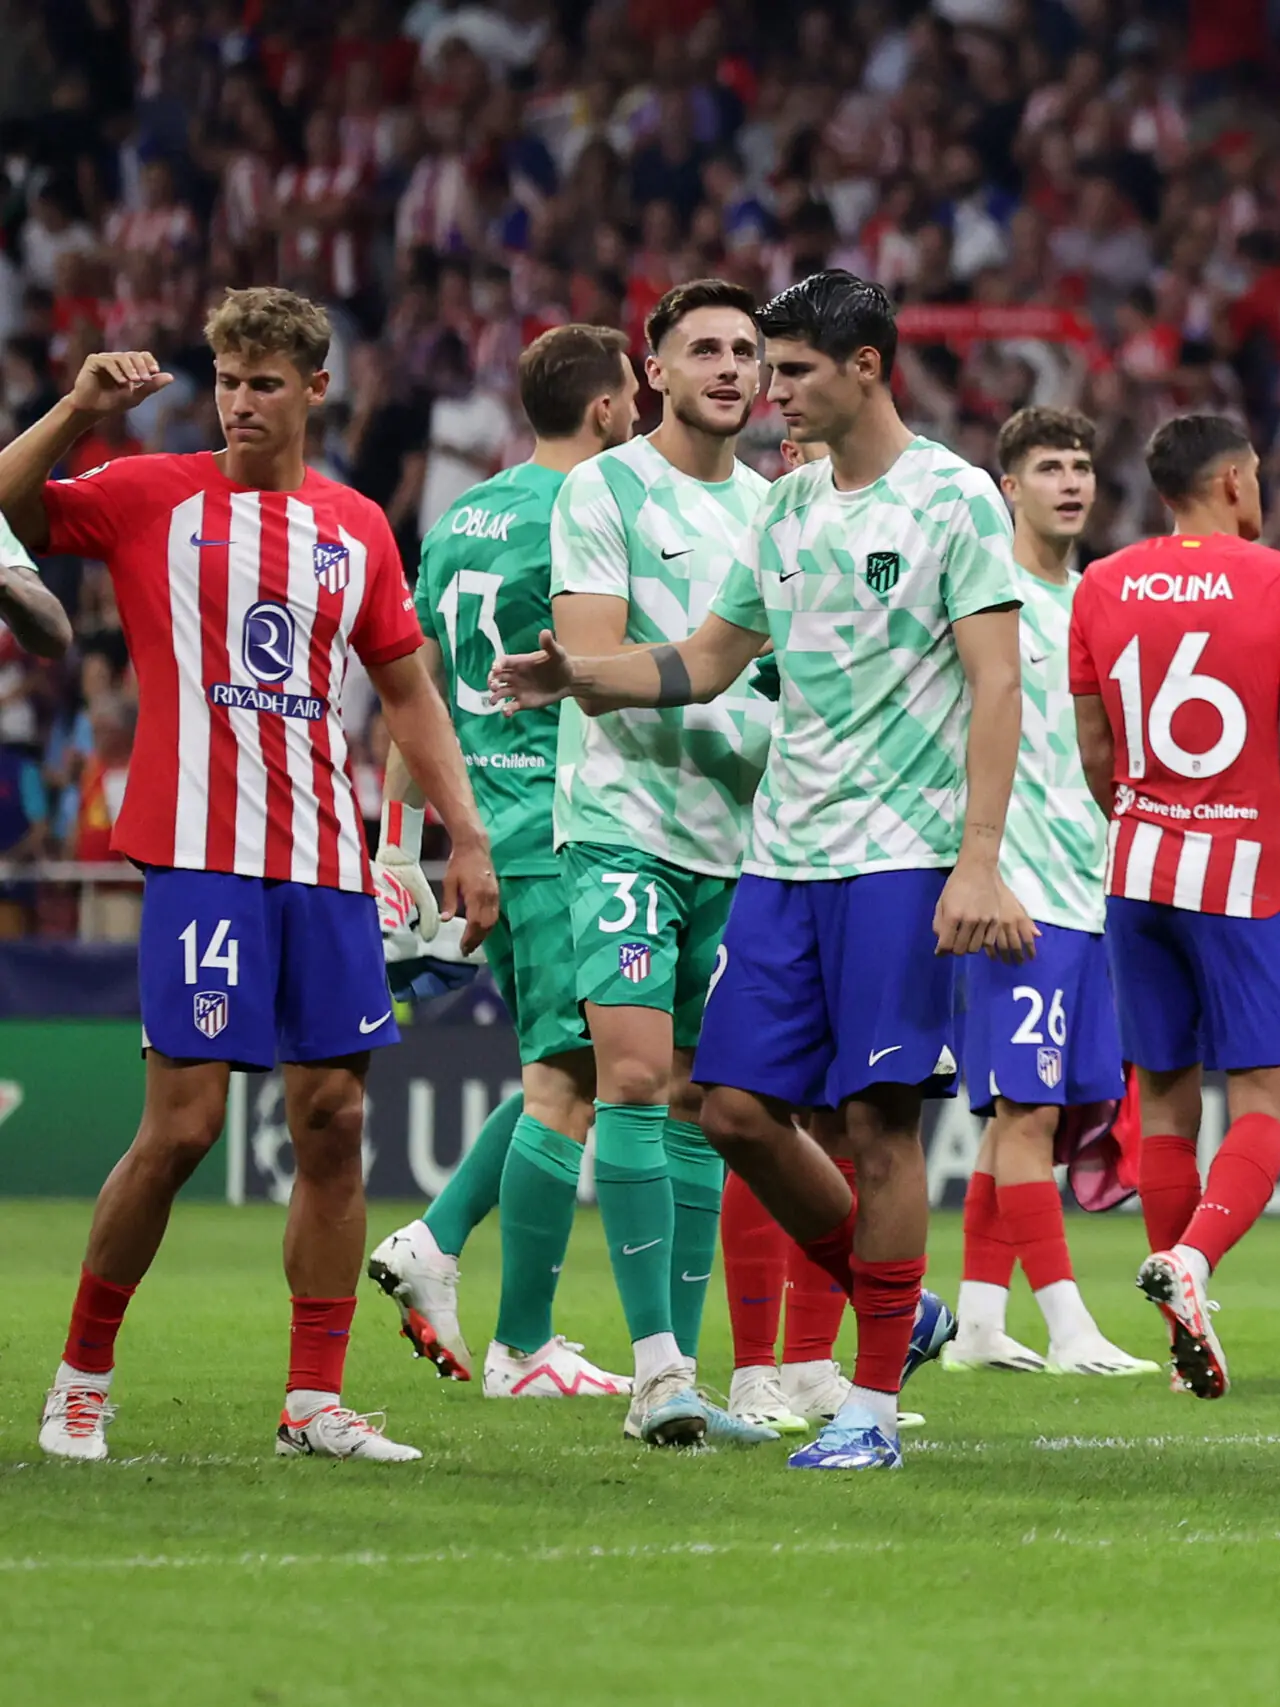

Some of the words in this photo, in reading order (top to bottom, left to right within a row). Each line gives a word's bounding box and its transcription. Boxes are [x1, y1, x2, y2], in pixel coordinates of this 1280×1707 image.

[451, 505, 517, 542] OBLAK
[1120, 572, 1234, 603] MOLINA
[436, 568, 505, 716] 13
[212, 684, 288, 714] RIYADH
[291, 698, 321, 720] AIR
[1108, 631, 1248, 779] 16
[490, 753, 546, 769] Children
[1136, 796, 1169, 816] Save
[1170, 804, 1191, 820] the
[1192, 804, 1259, 820] Children
[598, 872, 659, 936] 31
[178, 919, 239, 986] 14
[1010, 985, 1067, 1045] 26
